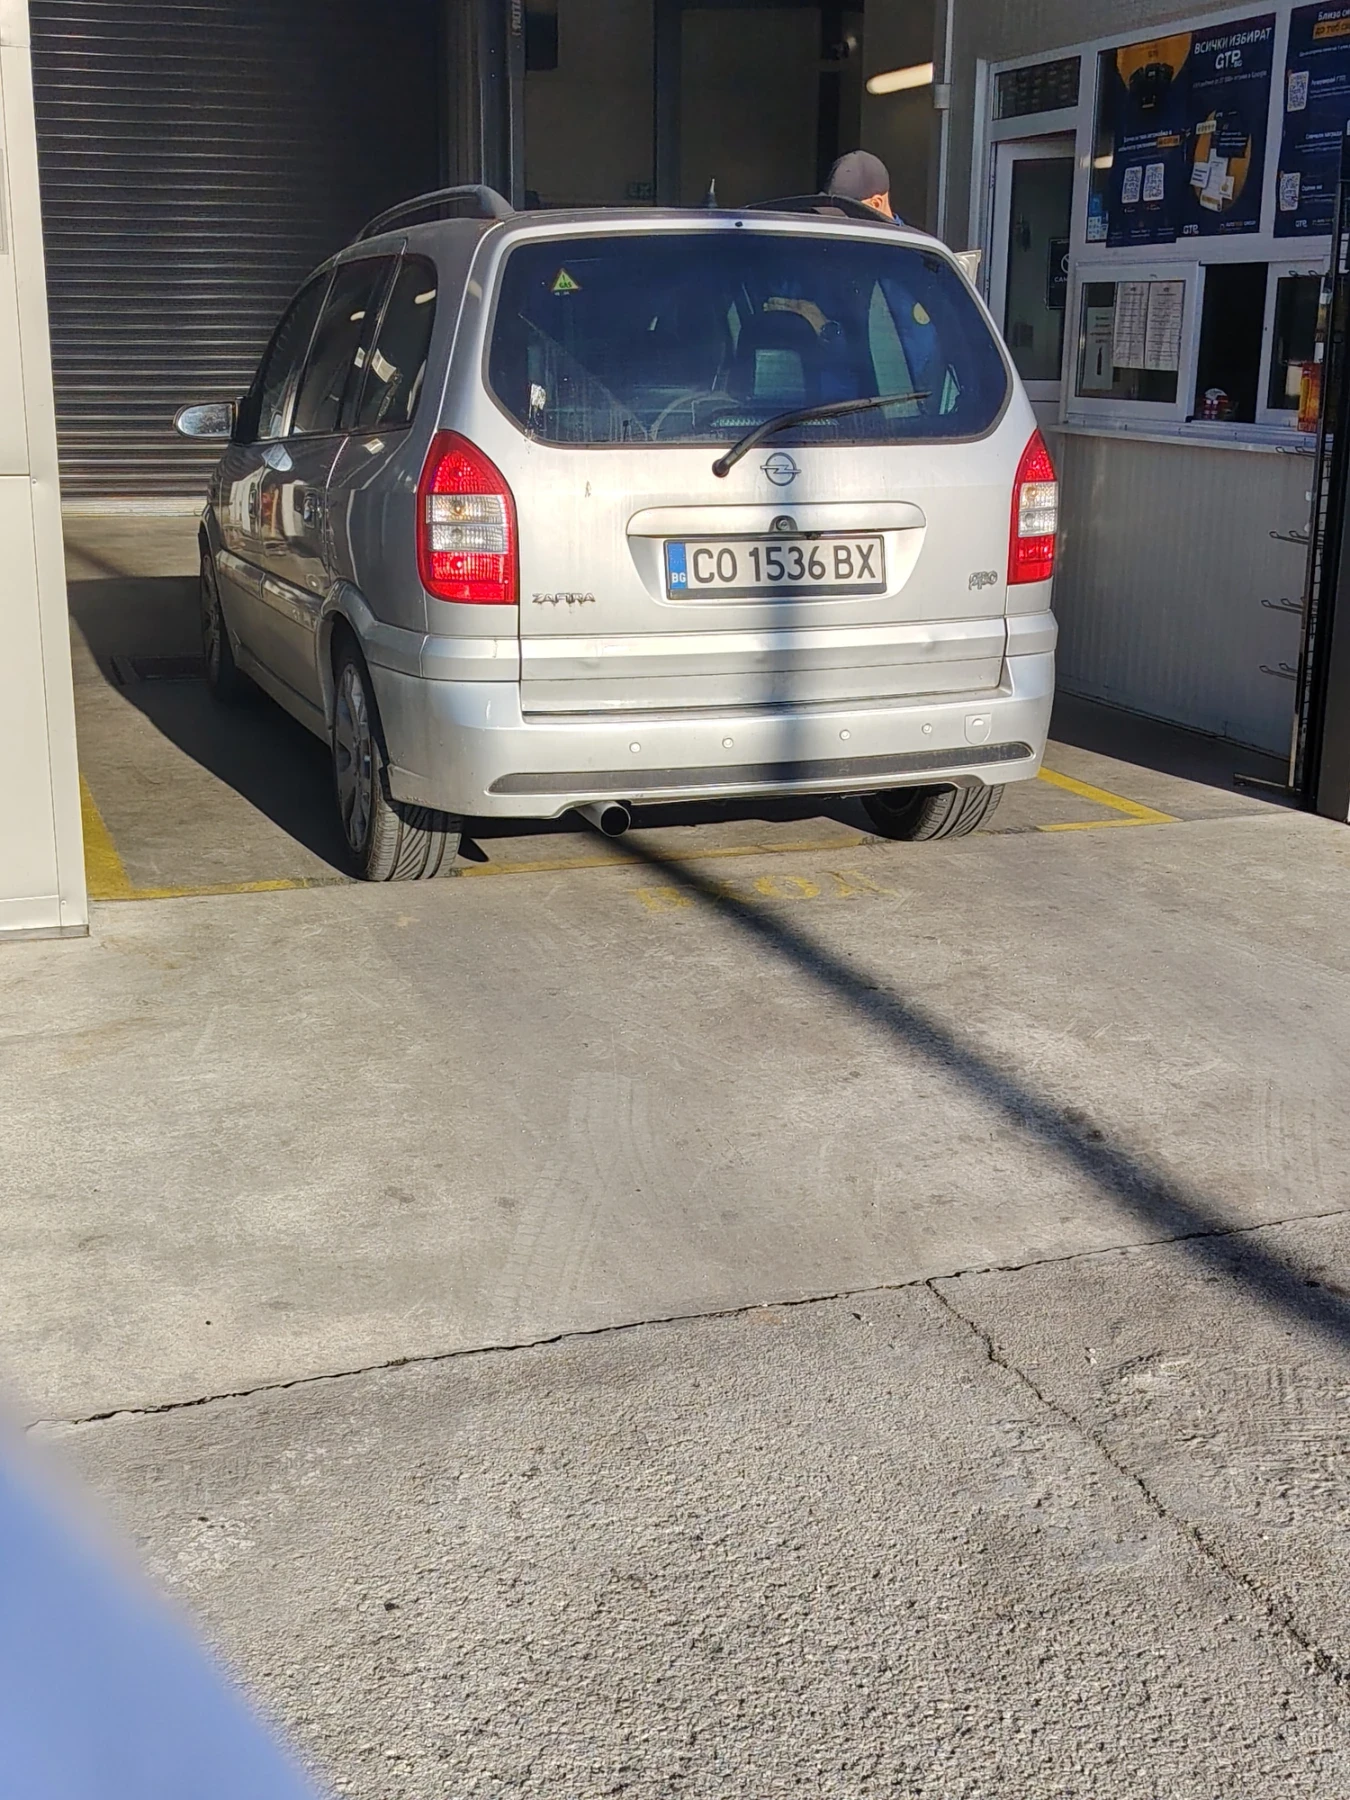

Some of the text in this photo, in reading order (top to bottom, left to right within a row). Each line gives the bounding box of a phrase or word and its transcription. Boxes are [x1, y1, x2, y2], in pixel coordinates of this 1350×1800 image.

[1194, 27, 1272, 55] ВСИЧКИ ИЗБИРАТ
[692, 543, 876, 584] CO 1536 BX
[671, 572, 687, 583] BG
[531, 591, 597, 605] ZAFIRA
